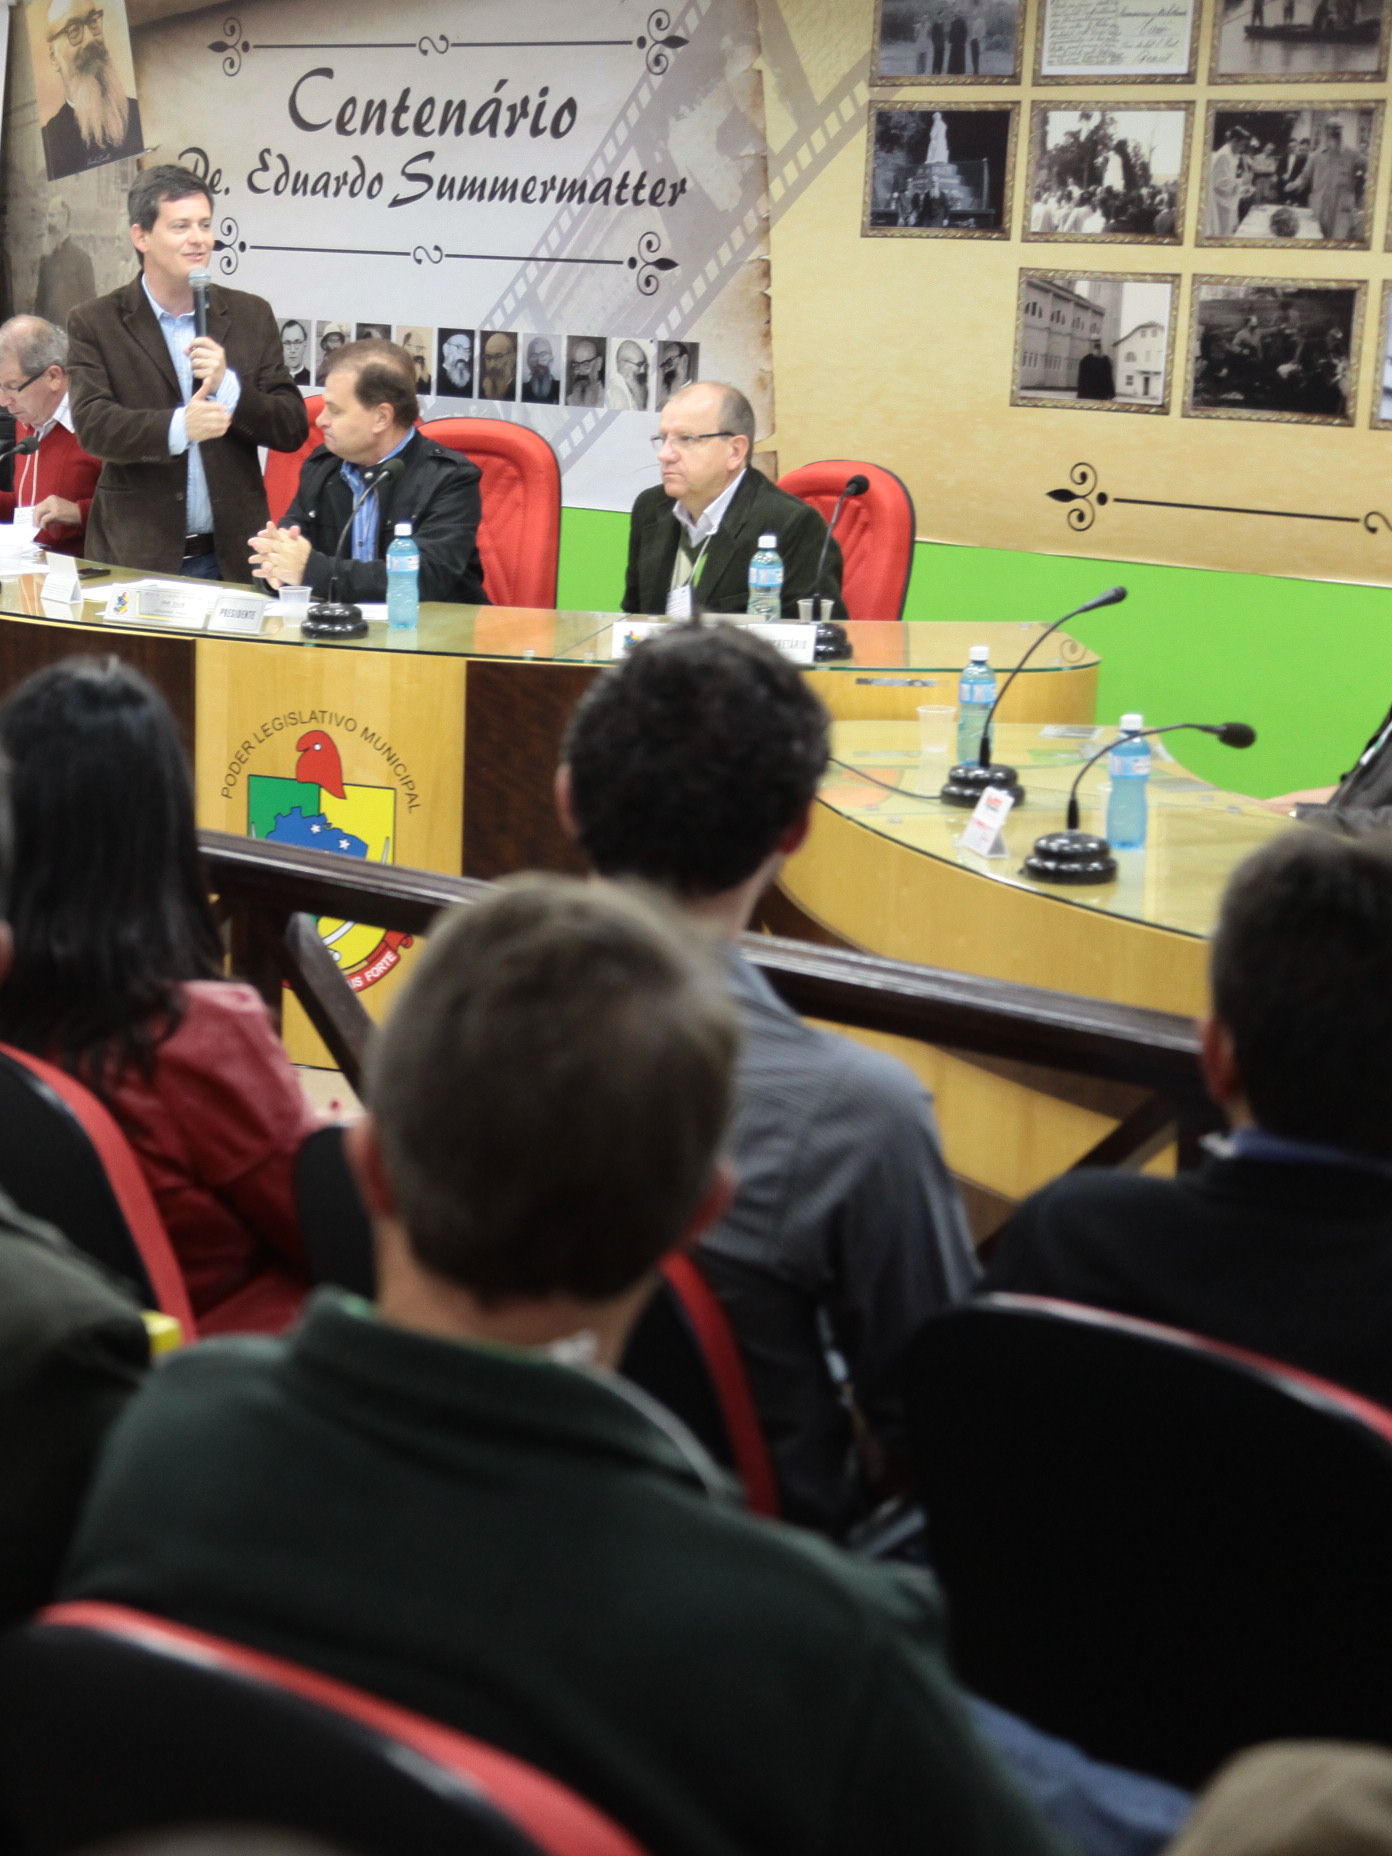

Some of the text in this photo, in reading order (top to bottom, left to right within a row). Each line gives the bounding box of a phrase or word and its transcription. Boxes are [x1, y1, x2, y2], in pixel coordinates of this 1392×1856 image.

[288, 67, 577, 139] Centenário
[247, 148, 384, 200] Eduardo
[388, 151, 687, 208] Summermatter
[219, 607, 257, 621] PRESIDENTE
[221, 710, 422, 815] PODER LEGISLATIVO MUNICIPAL
[364, 950, 398, 982] FORTE
